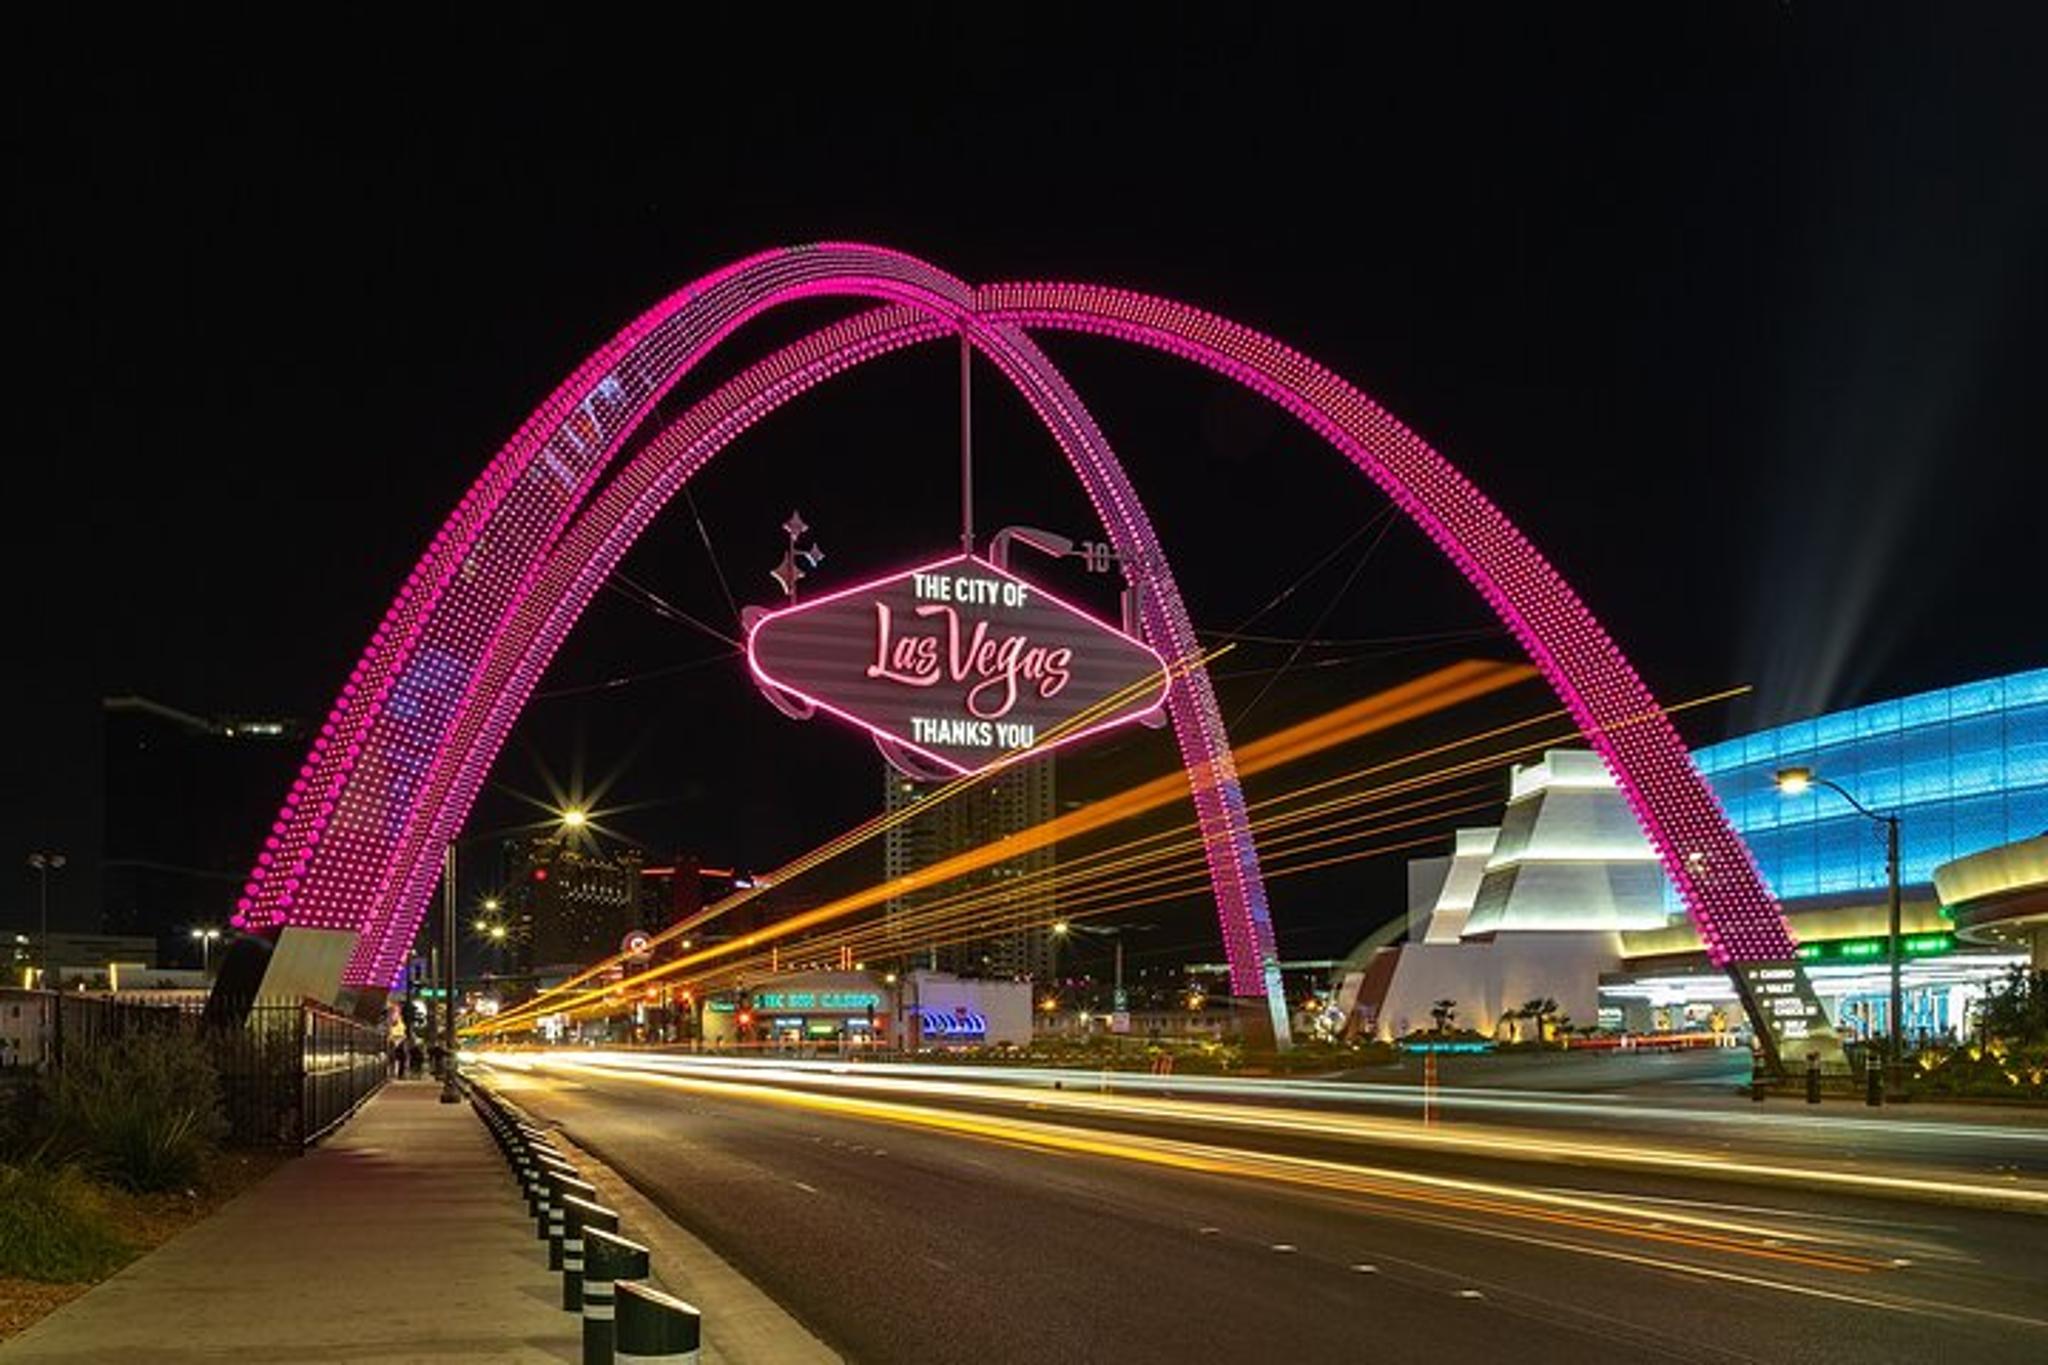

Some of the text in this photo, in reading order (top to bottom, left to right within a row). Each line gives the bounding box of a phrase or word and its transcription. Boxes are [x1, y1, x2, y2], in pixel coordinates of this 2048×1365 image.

[913, 573, 1029, 609] THE CITY OF
[866, 602, 1073, 718] Las Vegas
[911, 717, 1035, 750] THANKS YOU
